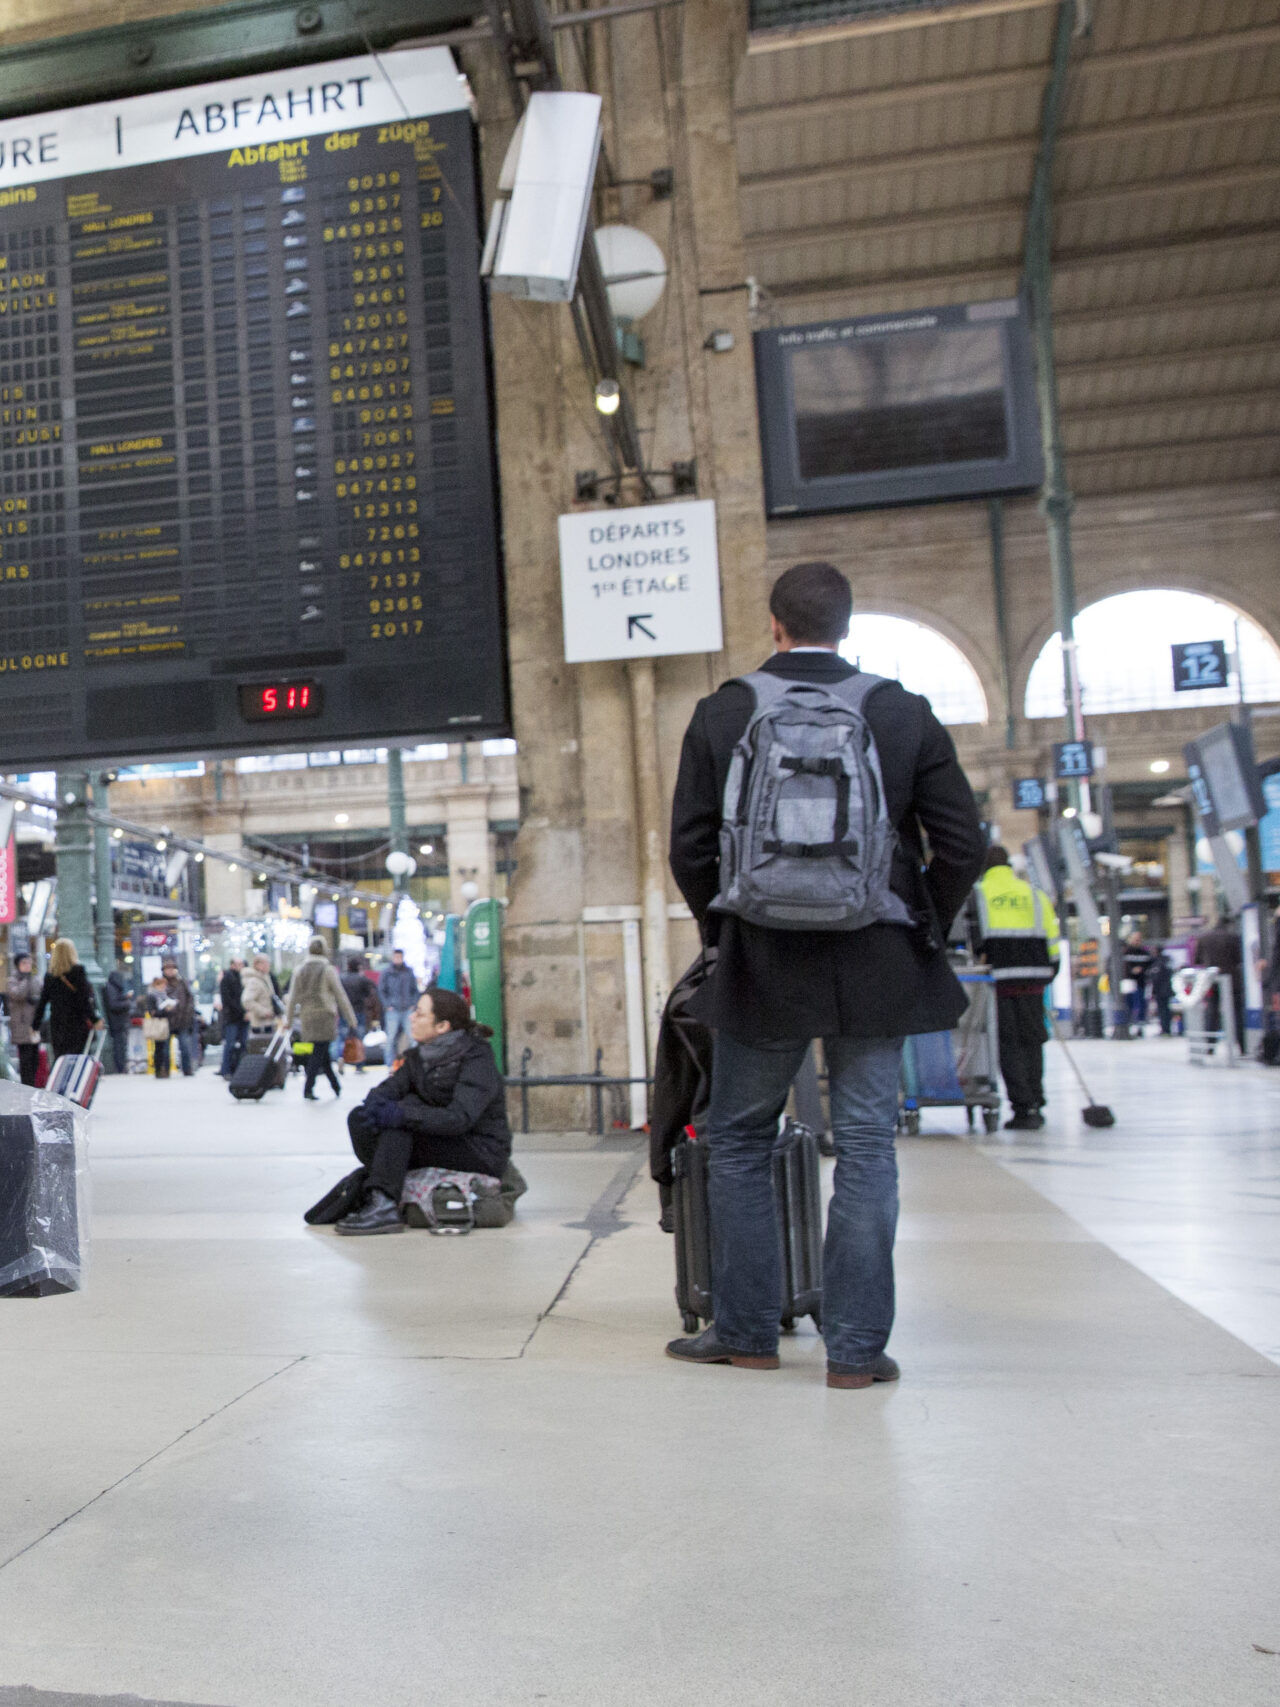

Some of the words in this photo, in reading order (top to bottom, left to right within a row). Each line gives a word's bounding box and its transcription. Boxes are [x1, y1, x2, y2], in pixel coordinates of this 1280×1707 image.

[175, 75, 373, 142] ABFAHRT
[227, 138, 309, 168] Abfahrt
[324, 132, 360, 152] der
[377, 121, 433, 144] züge
[421, 212, 443, 227] 20
[329, 334, 407, 357] 847427
[354, 500, 417, 518] 12313
[589, 518, 686, 544] DÉPARTS
[588, 546, 690, 572] LONDRES
[371, 572, 420, 587] 7137
[622, 574, 690, 597] ÉTAGE
[372, 620, 423, 638] 2017
[1182, 655, 1220, 681] 12
[1060, 751, 1088, 770] 11
